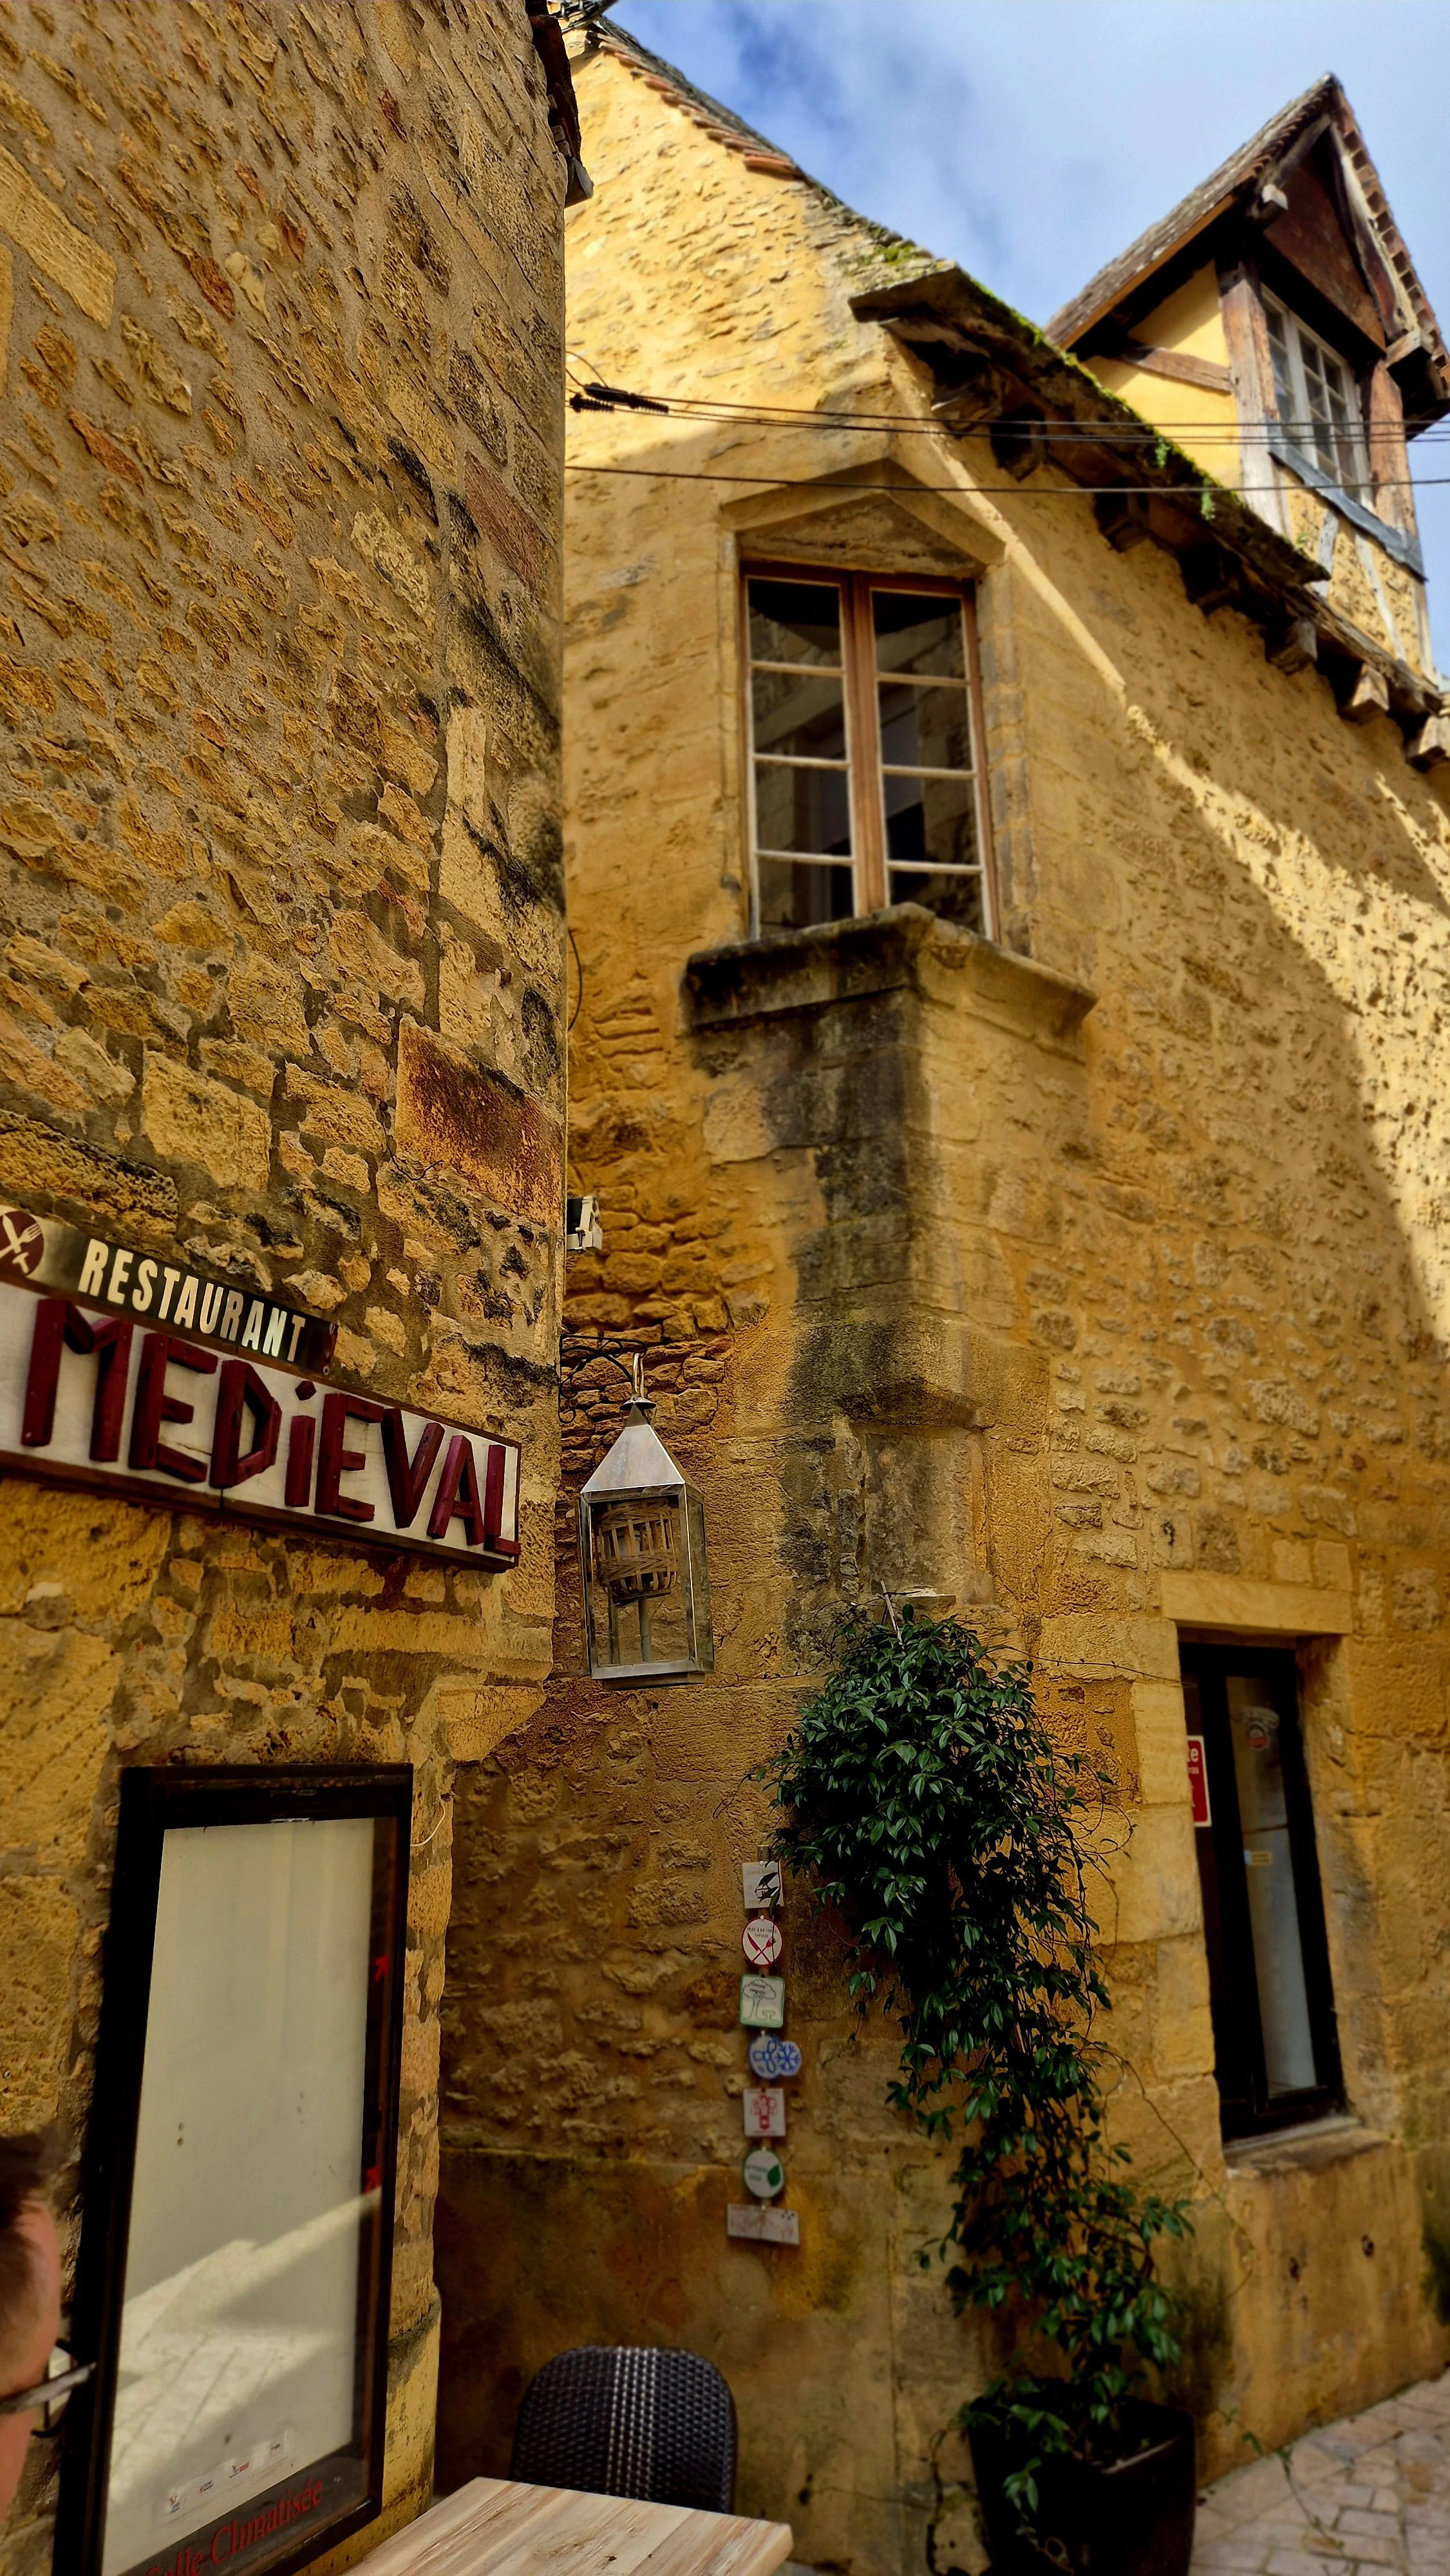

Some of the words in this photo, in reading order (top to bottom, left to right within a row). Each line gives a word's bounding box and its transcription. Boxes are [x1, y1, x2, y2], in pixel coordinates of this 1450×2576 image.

[79, 1238, 306, 1363] RESTAURANT
[146, 2546, 204, 2576] lle
[211, 2476, 323, 2565] Climatisée
